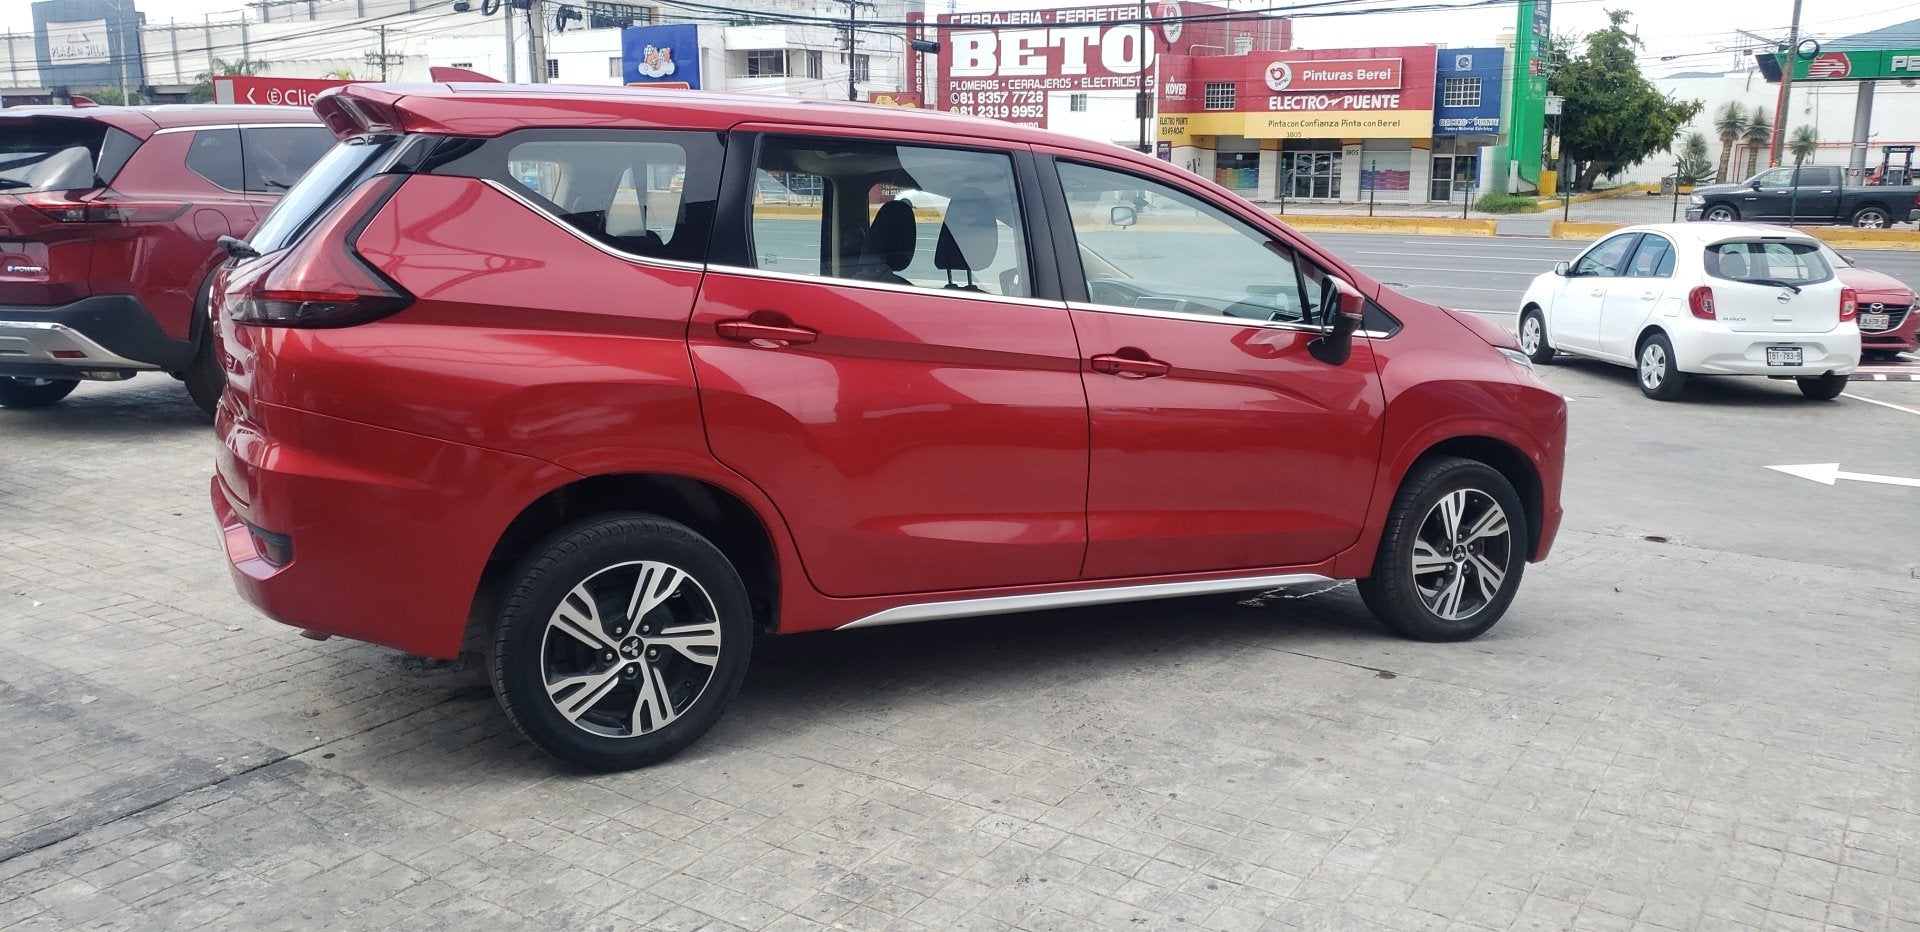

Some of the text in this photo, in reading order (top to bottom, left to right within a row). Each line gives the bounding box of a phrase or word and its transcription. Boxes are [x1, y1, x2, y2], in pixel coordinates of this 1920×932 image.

[950, 24, 1155, 77] BETO
[1303, 68, 1391, 81] Pinturas Berel
[950, 75, 1154, 91] PLOMEROS CERRAJEROS ELECTRICISTS
[960, 90, 1044, 104] 81 8357 7728
[1268, 94, 1400, 110] ELECTRO PUENTE
[960, 105, 1044, 118] 81 2319 9952
[1268, 119, 1286, 128] Pinta
[1300, 119, 1339, 128] Confianza
[1341, 119, 1361, 128] Pinta
[1377, 120, 1400, 128] Berel
